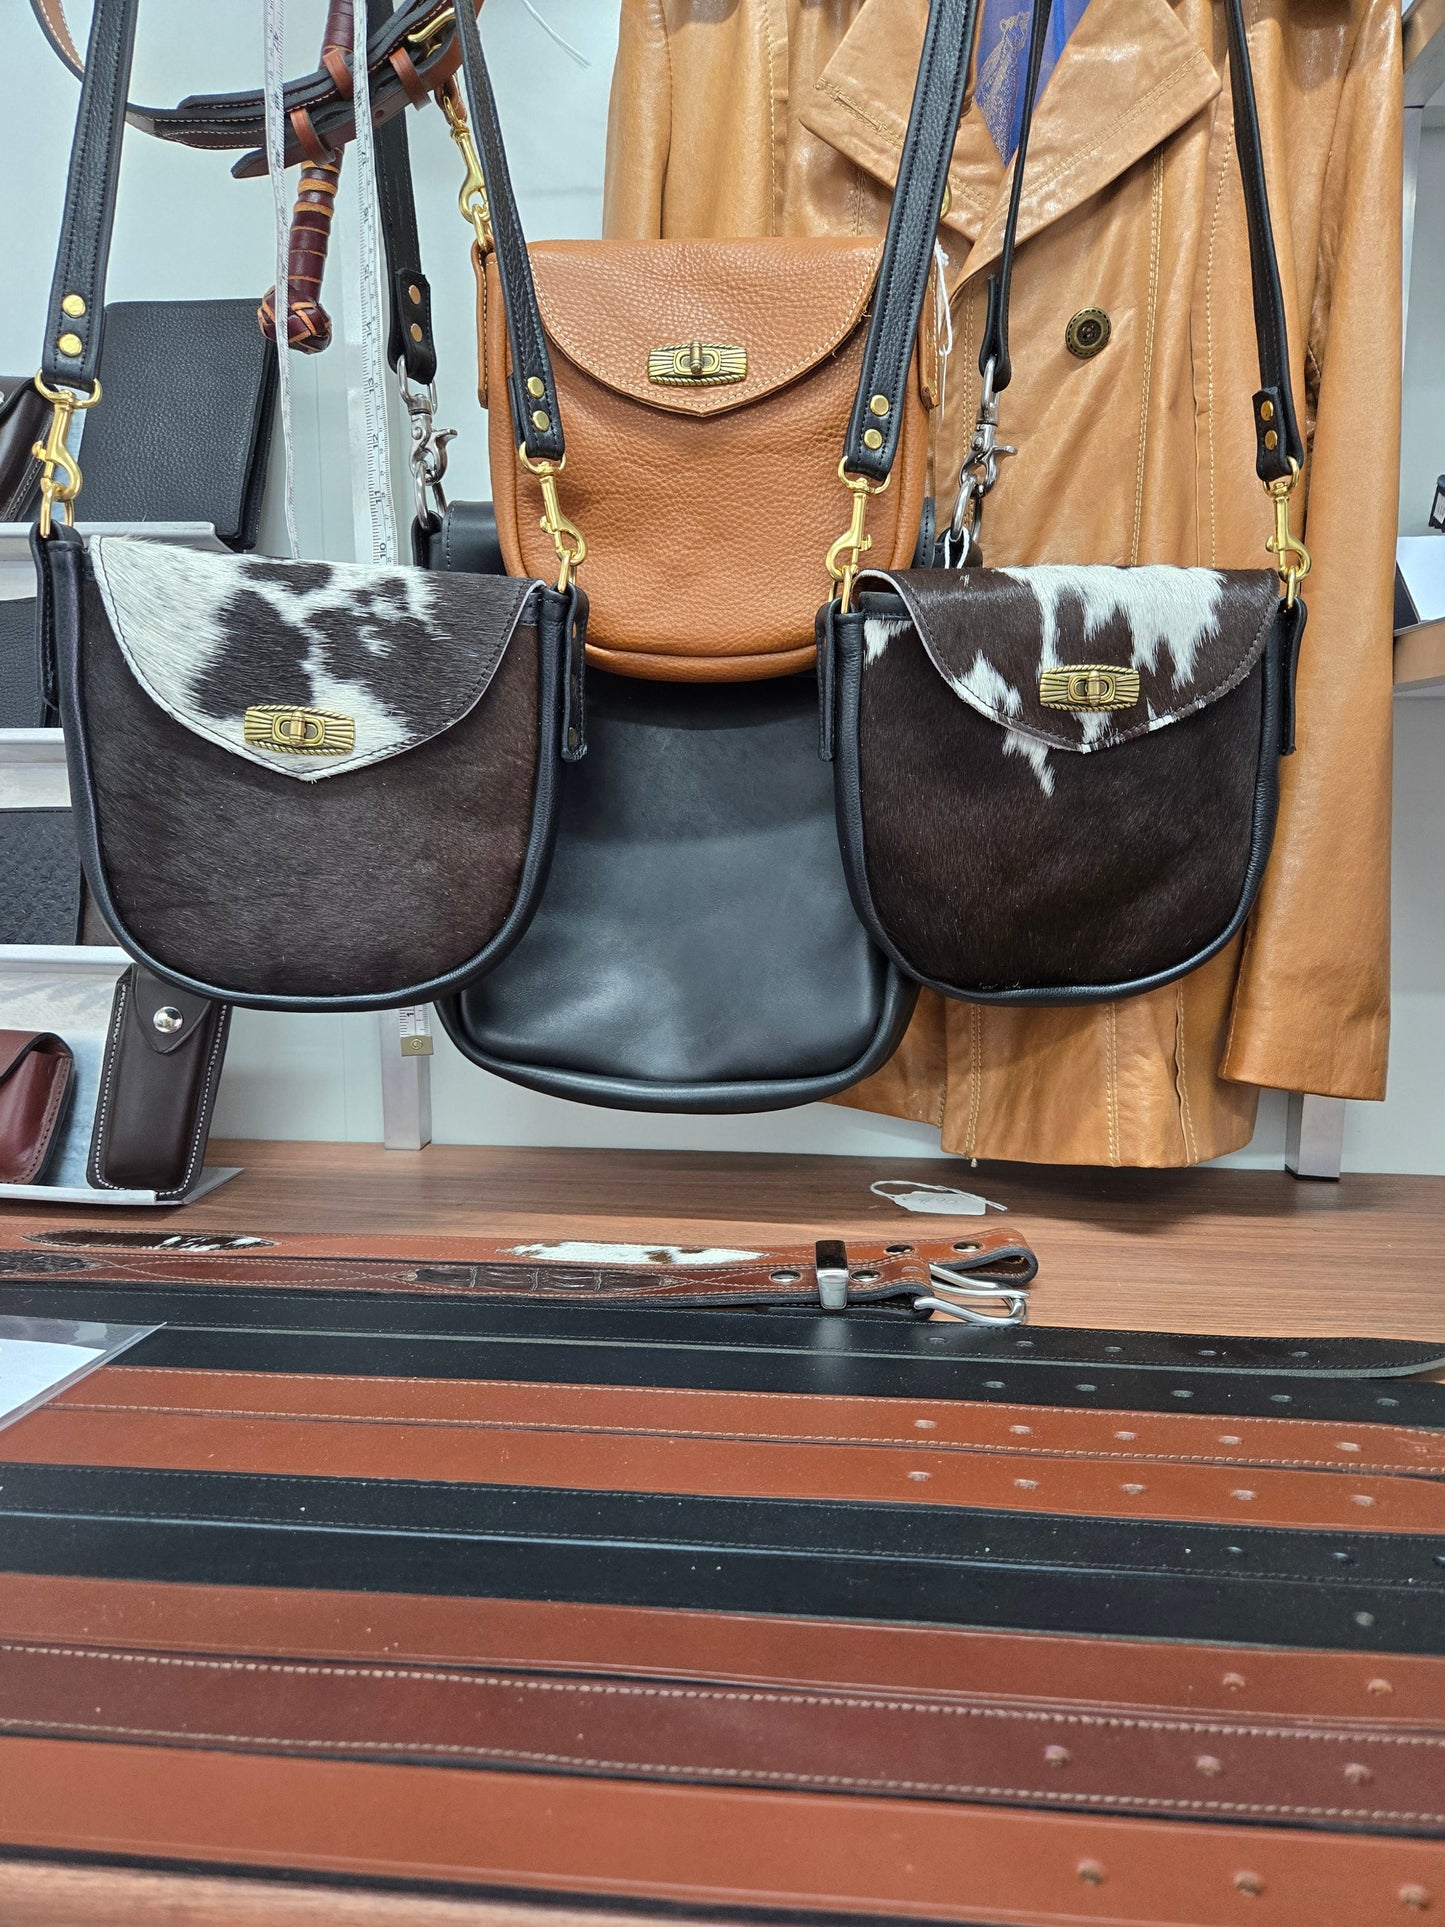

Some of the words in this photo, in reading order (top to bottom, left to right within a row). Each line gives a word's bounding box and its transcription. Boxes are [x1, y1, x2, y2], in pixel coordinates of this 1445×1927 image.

[366, 321, 372, 338] 14
[368, 377, 375, 394] 13
[372, 433, 379, 450] 12
[374, 490, 382, 504] 11
[379, 543, 387, 559] 10
